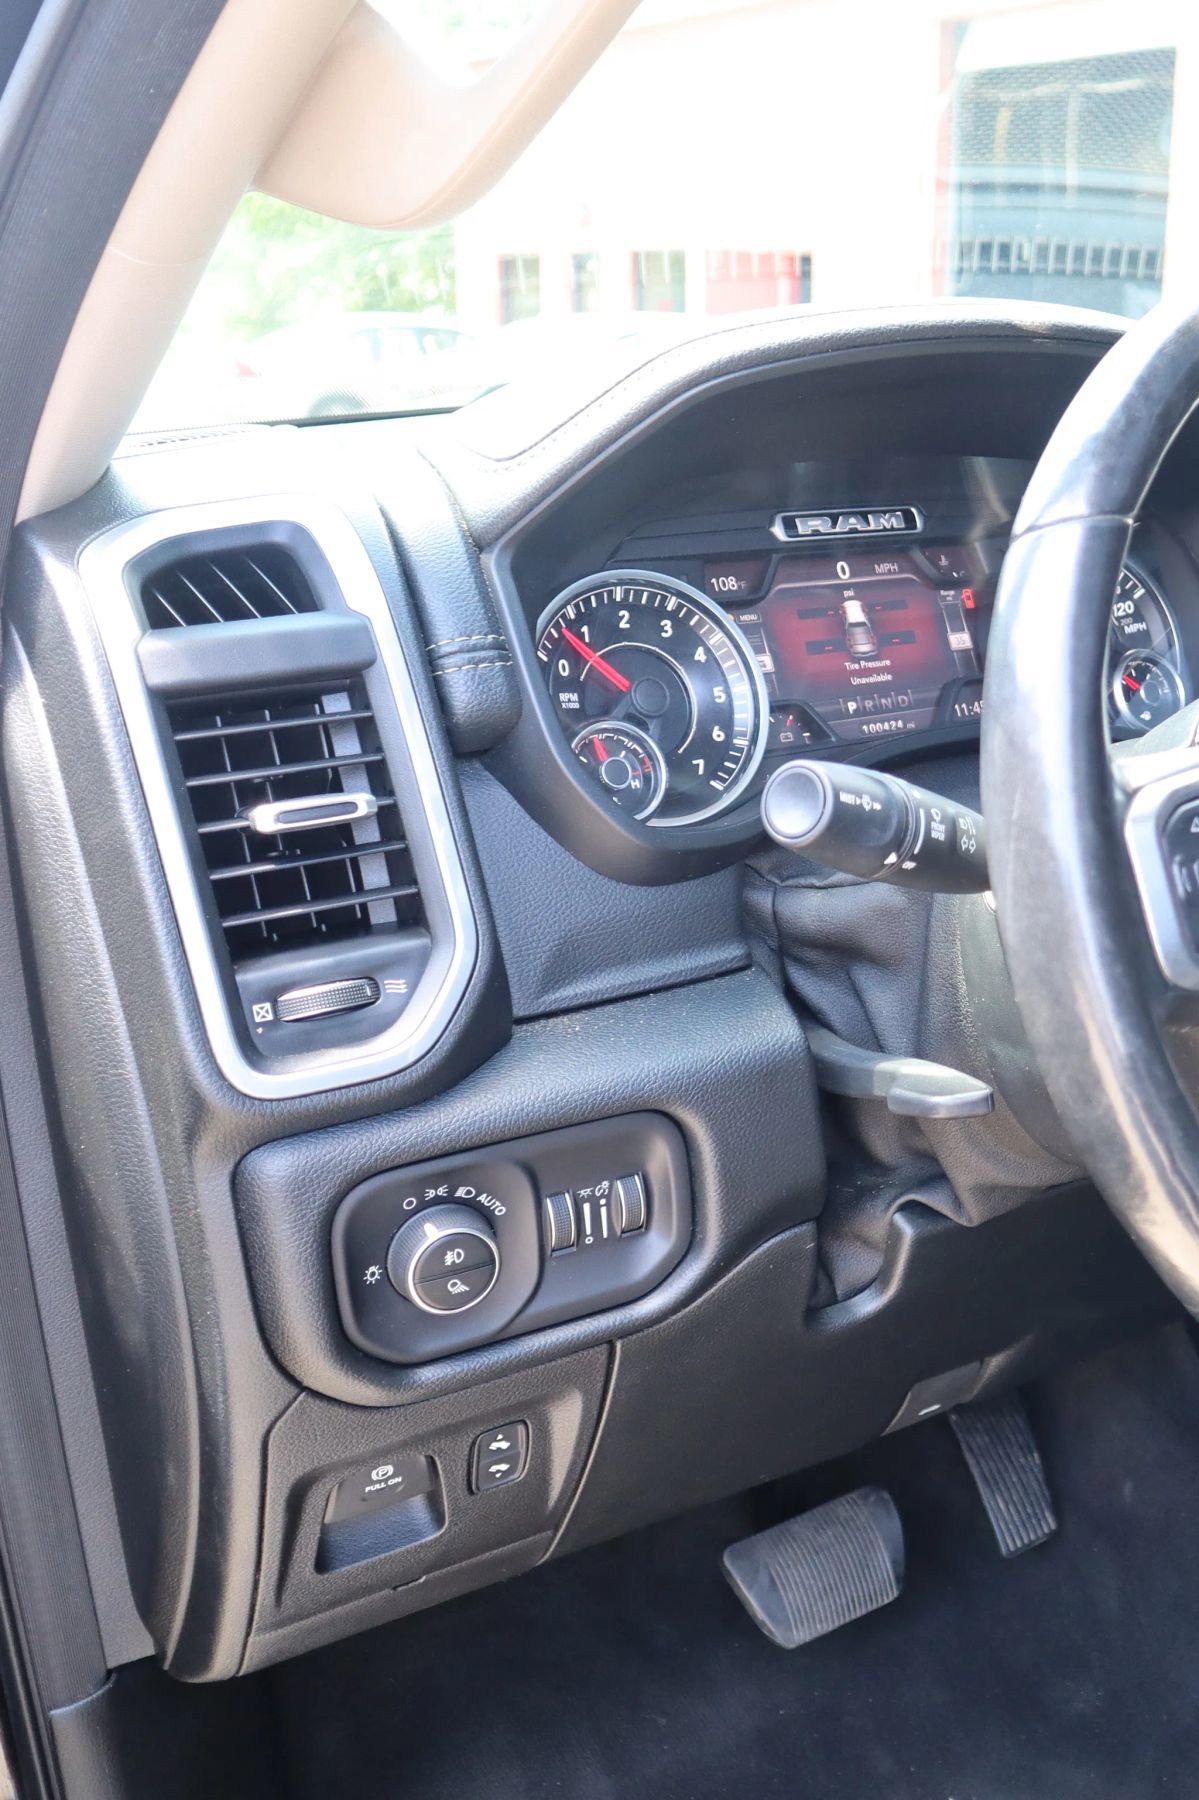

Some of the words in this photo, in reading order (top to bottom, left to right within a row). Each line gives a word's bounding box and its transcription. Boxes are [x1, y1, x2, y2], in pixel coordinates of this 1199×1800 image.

[795, 511, 905, 534] RAM
[835, 561, 850, 580] 0
[874, 562, 899, 574] MPH
[843, 589, 855, 598] psi
[1113, 600, 1135, 617] 120
[618, 610, 631, 629] 2
[580, 625, 590, 643] 1
[660, 619, 673, 638] 3
[1124, 622, 1147, 634] MPH
[694, 646, 707, 663] 4
[558, 658, 570, 677] 0
[844, 661, 860, 670] Tire
[860, 660, 892, 669] Pressure
[850, 672, 893, 685] Unavailable
[559, 692, 579, 702] RPM
[713, 686, 727, 703] 5
[712, 726, 726, 741] 6
[861, 720, 903, 734] 100424
[692, 759, 705, 775] 7
[631, 778, 640, 789] H
[839, 791, 856, 805] MIST
[931, 821, 946, 832] FRONT
[902, 861, 917, 870] OFF
[476, 1192, 506, 1216] AUTO
[365, 1482, 387, 1492] PULL
[387, 1476, 402, 1485] ON
